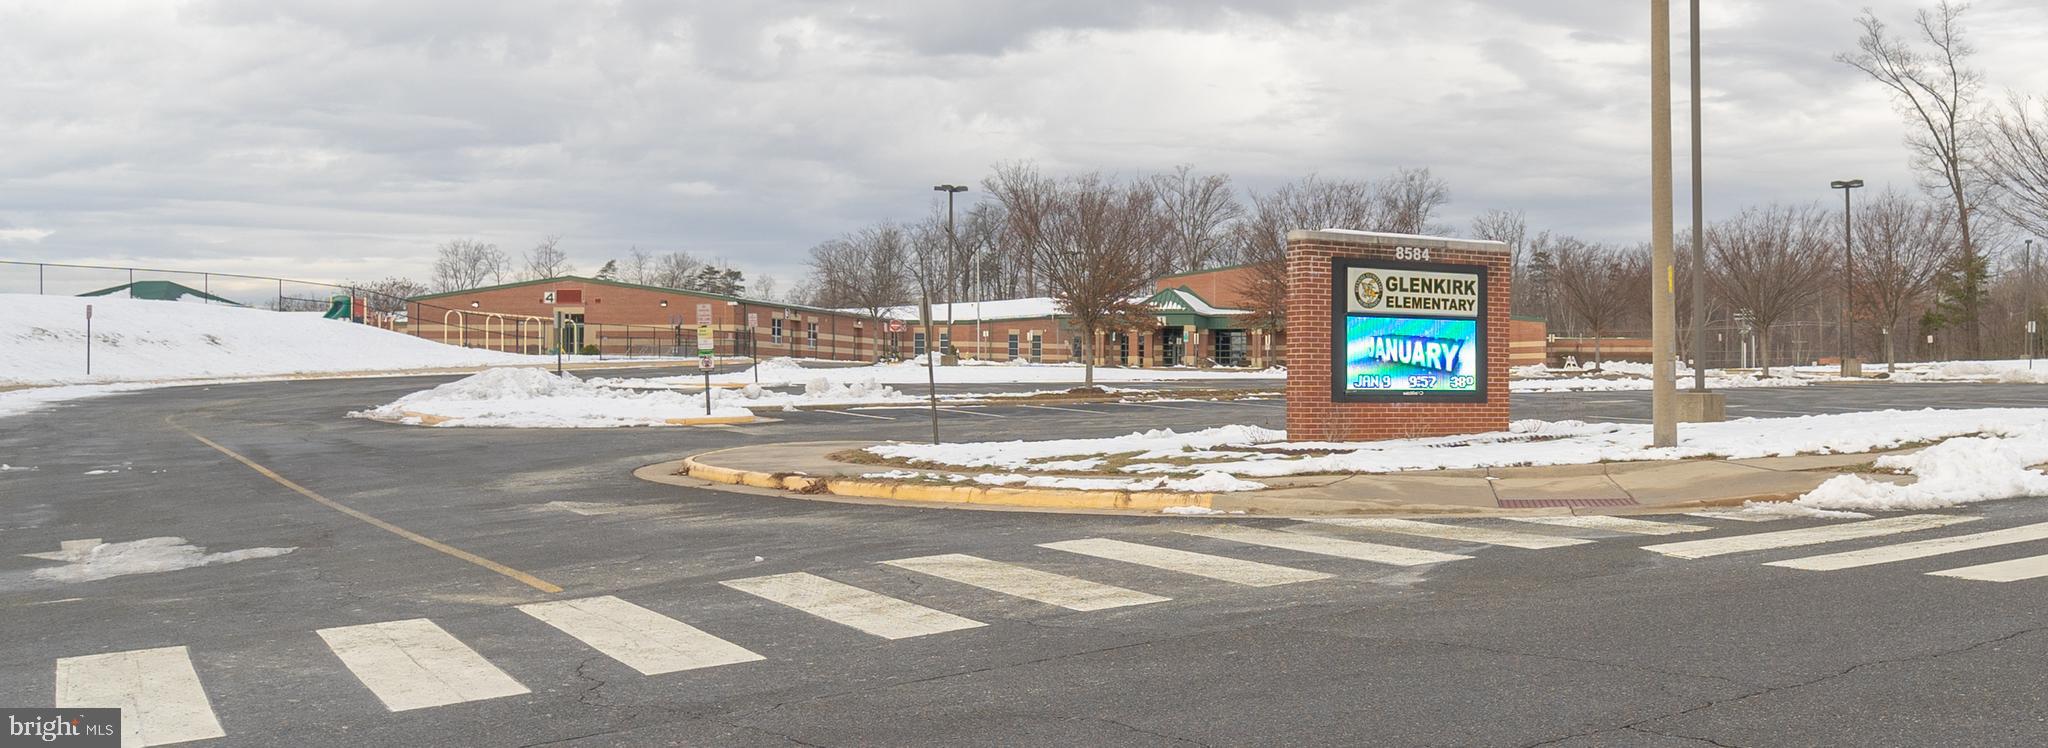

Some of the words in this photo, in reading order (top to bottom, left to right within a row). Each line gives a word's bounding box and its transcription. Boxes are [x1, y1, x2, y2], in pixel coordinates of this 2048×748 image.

[1396, 246, 1430, 261] 8584
[1386, 276, 1476, 296] GLENKIRK
[545, 293, 554, 303] 4
[1386, 296, 1475, 311] ELEMENTARY
[1367, 336, 1459, 372] JANUARY
[1354, 374, 1379, 388] JAN
[1382, 375, 1391, 388] 9
[1408, 375, 1437, 388] 9:57
